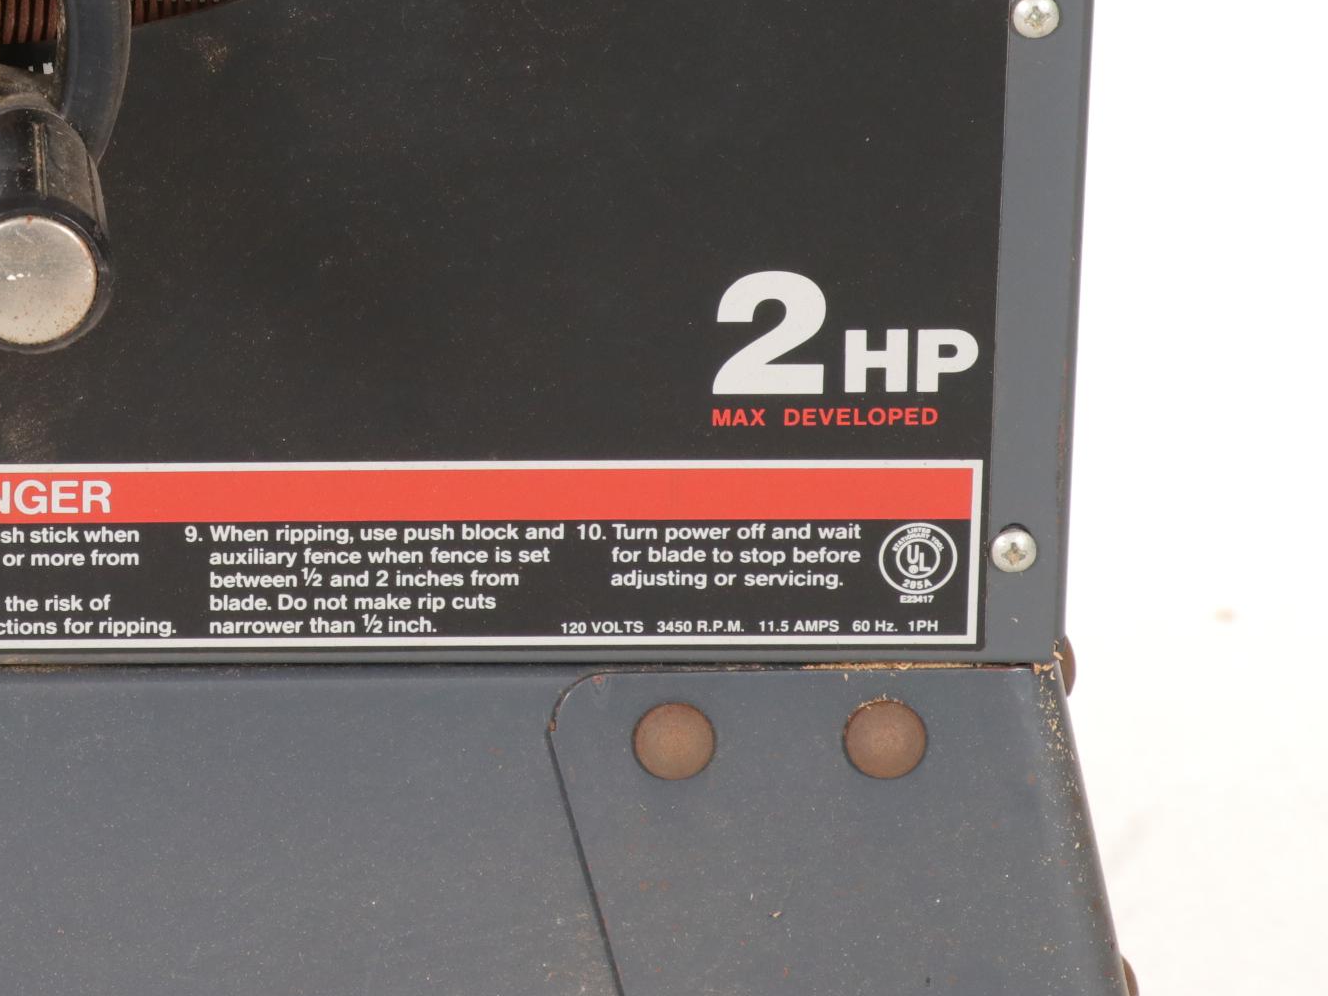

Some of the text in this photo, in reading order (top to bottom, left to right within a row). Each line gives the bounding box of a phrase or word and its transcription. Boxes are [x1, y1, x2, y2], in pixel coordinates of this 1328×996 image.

[712, 270, 979, 395] 2 HP
[712, 407, 939, 427] MAX DEVELOPED
[29, 526, 80, 544] stick
[83, 525, 140, 544] when
[184, 522, 565, 545] 9. When ripping, use push block and
[576, 522, 862, 544] 10. Turn power off and wait
[2, 553, 26, 567] or
[30, 552, 86, 567] more
[89, 548, 140, 567] from
[208, 546, 551, 568] auxiliary fence when fence is set
[611, 545, 862, 567] for blade to stop before
[209, 571, 298, 589] between
[329, 569, 370, 588] and
[375, 569, 389, 588] 2
[395, 569, 465, 588] inches
[469, 569, 520, 587] from
[610, 569, 844, 590] adjusting or servicing.
[4, 595, 39, 613] the
[44, 594, 84, 612] risk
[88, 593, 112, 612] of
[209, 592, 497, 613] blade. Do not make rip cuts
[63, 617, 94, 635] for
[98, 616, 177, 638] ripping.
[209, 620, 304, 635] narrower
[308, 616, 356, 634] than
[387, 615, 438, 634] inch.
[560, 619, 939, 635] 120 VOLTS 3450 R.P.M. 11.5 AMPS 60 Hz. 1PH
